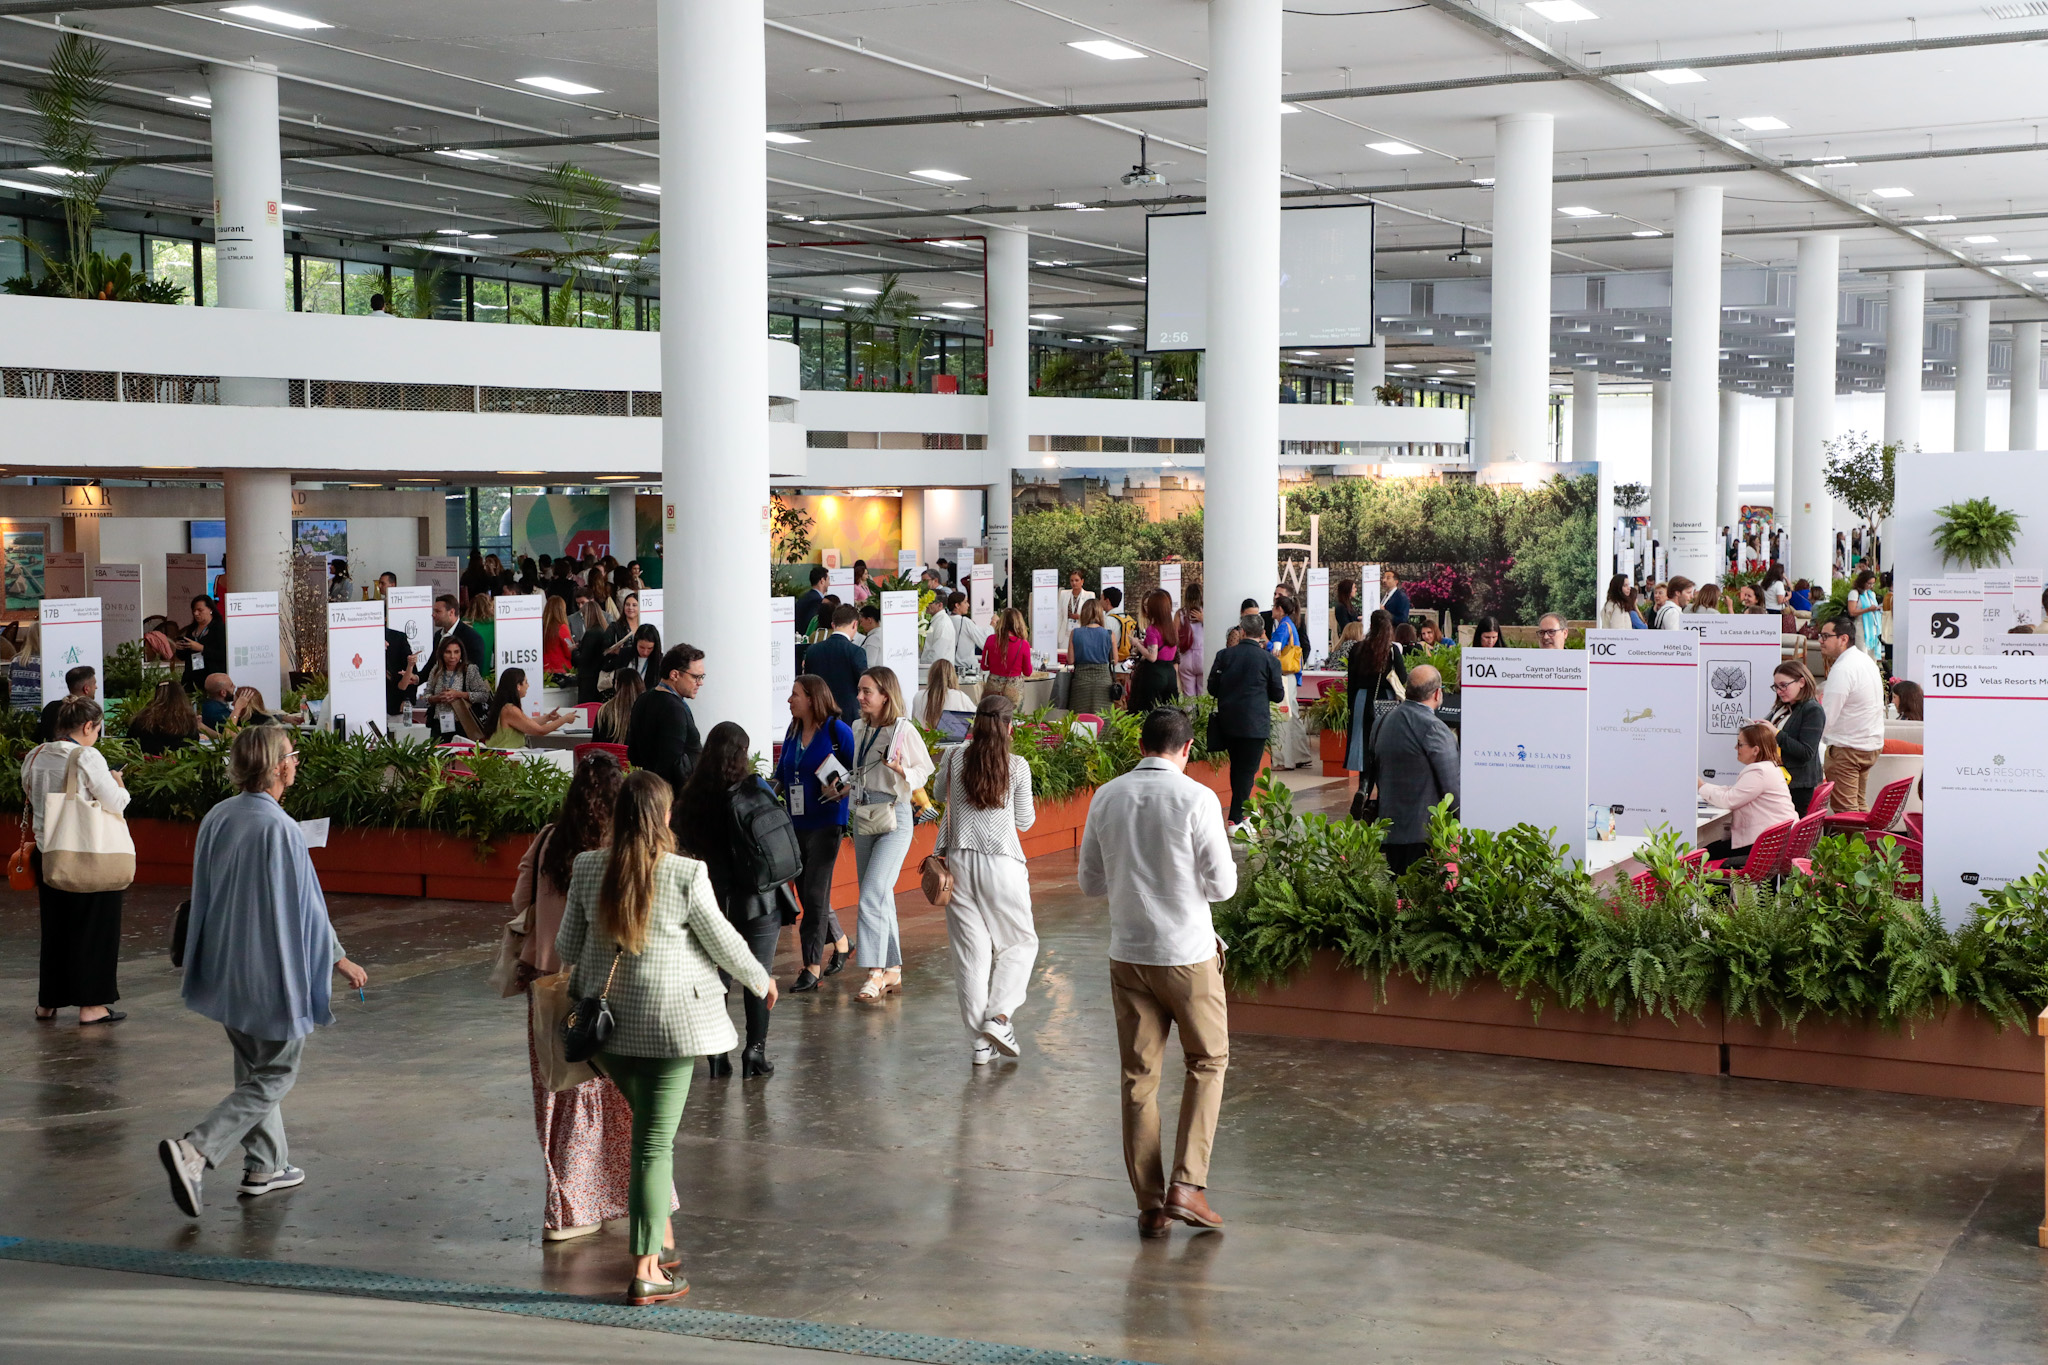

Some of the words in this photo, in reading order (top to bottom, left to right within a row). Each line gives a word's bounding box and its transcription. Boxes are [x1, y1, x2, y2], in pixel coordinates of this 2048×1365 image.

[1160, 331, 1189, 344] 2:56
[1912, 588, 1932, 596] 10G
[229, 603, 242, 611] 17E
[642, 598, 653, 607] 17G
[884, 601, 892, 609] 17F
[44, 609, 59, 618] 17B
[498, 606, 510, 614] 17D
[332, 613, 346, 622] 17A
[1590, 643, 1616, 655] 10C
[340, 669, 378, 679] ACQUALINA
[1466, 664, 1497, 678] 10A
[1932, 673, 1968, 687] 10B
[1720, 702, 1744, 714] CASA
[1956, 767, 1991, 776] VELAS
